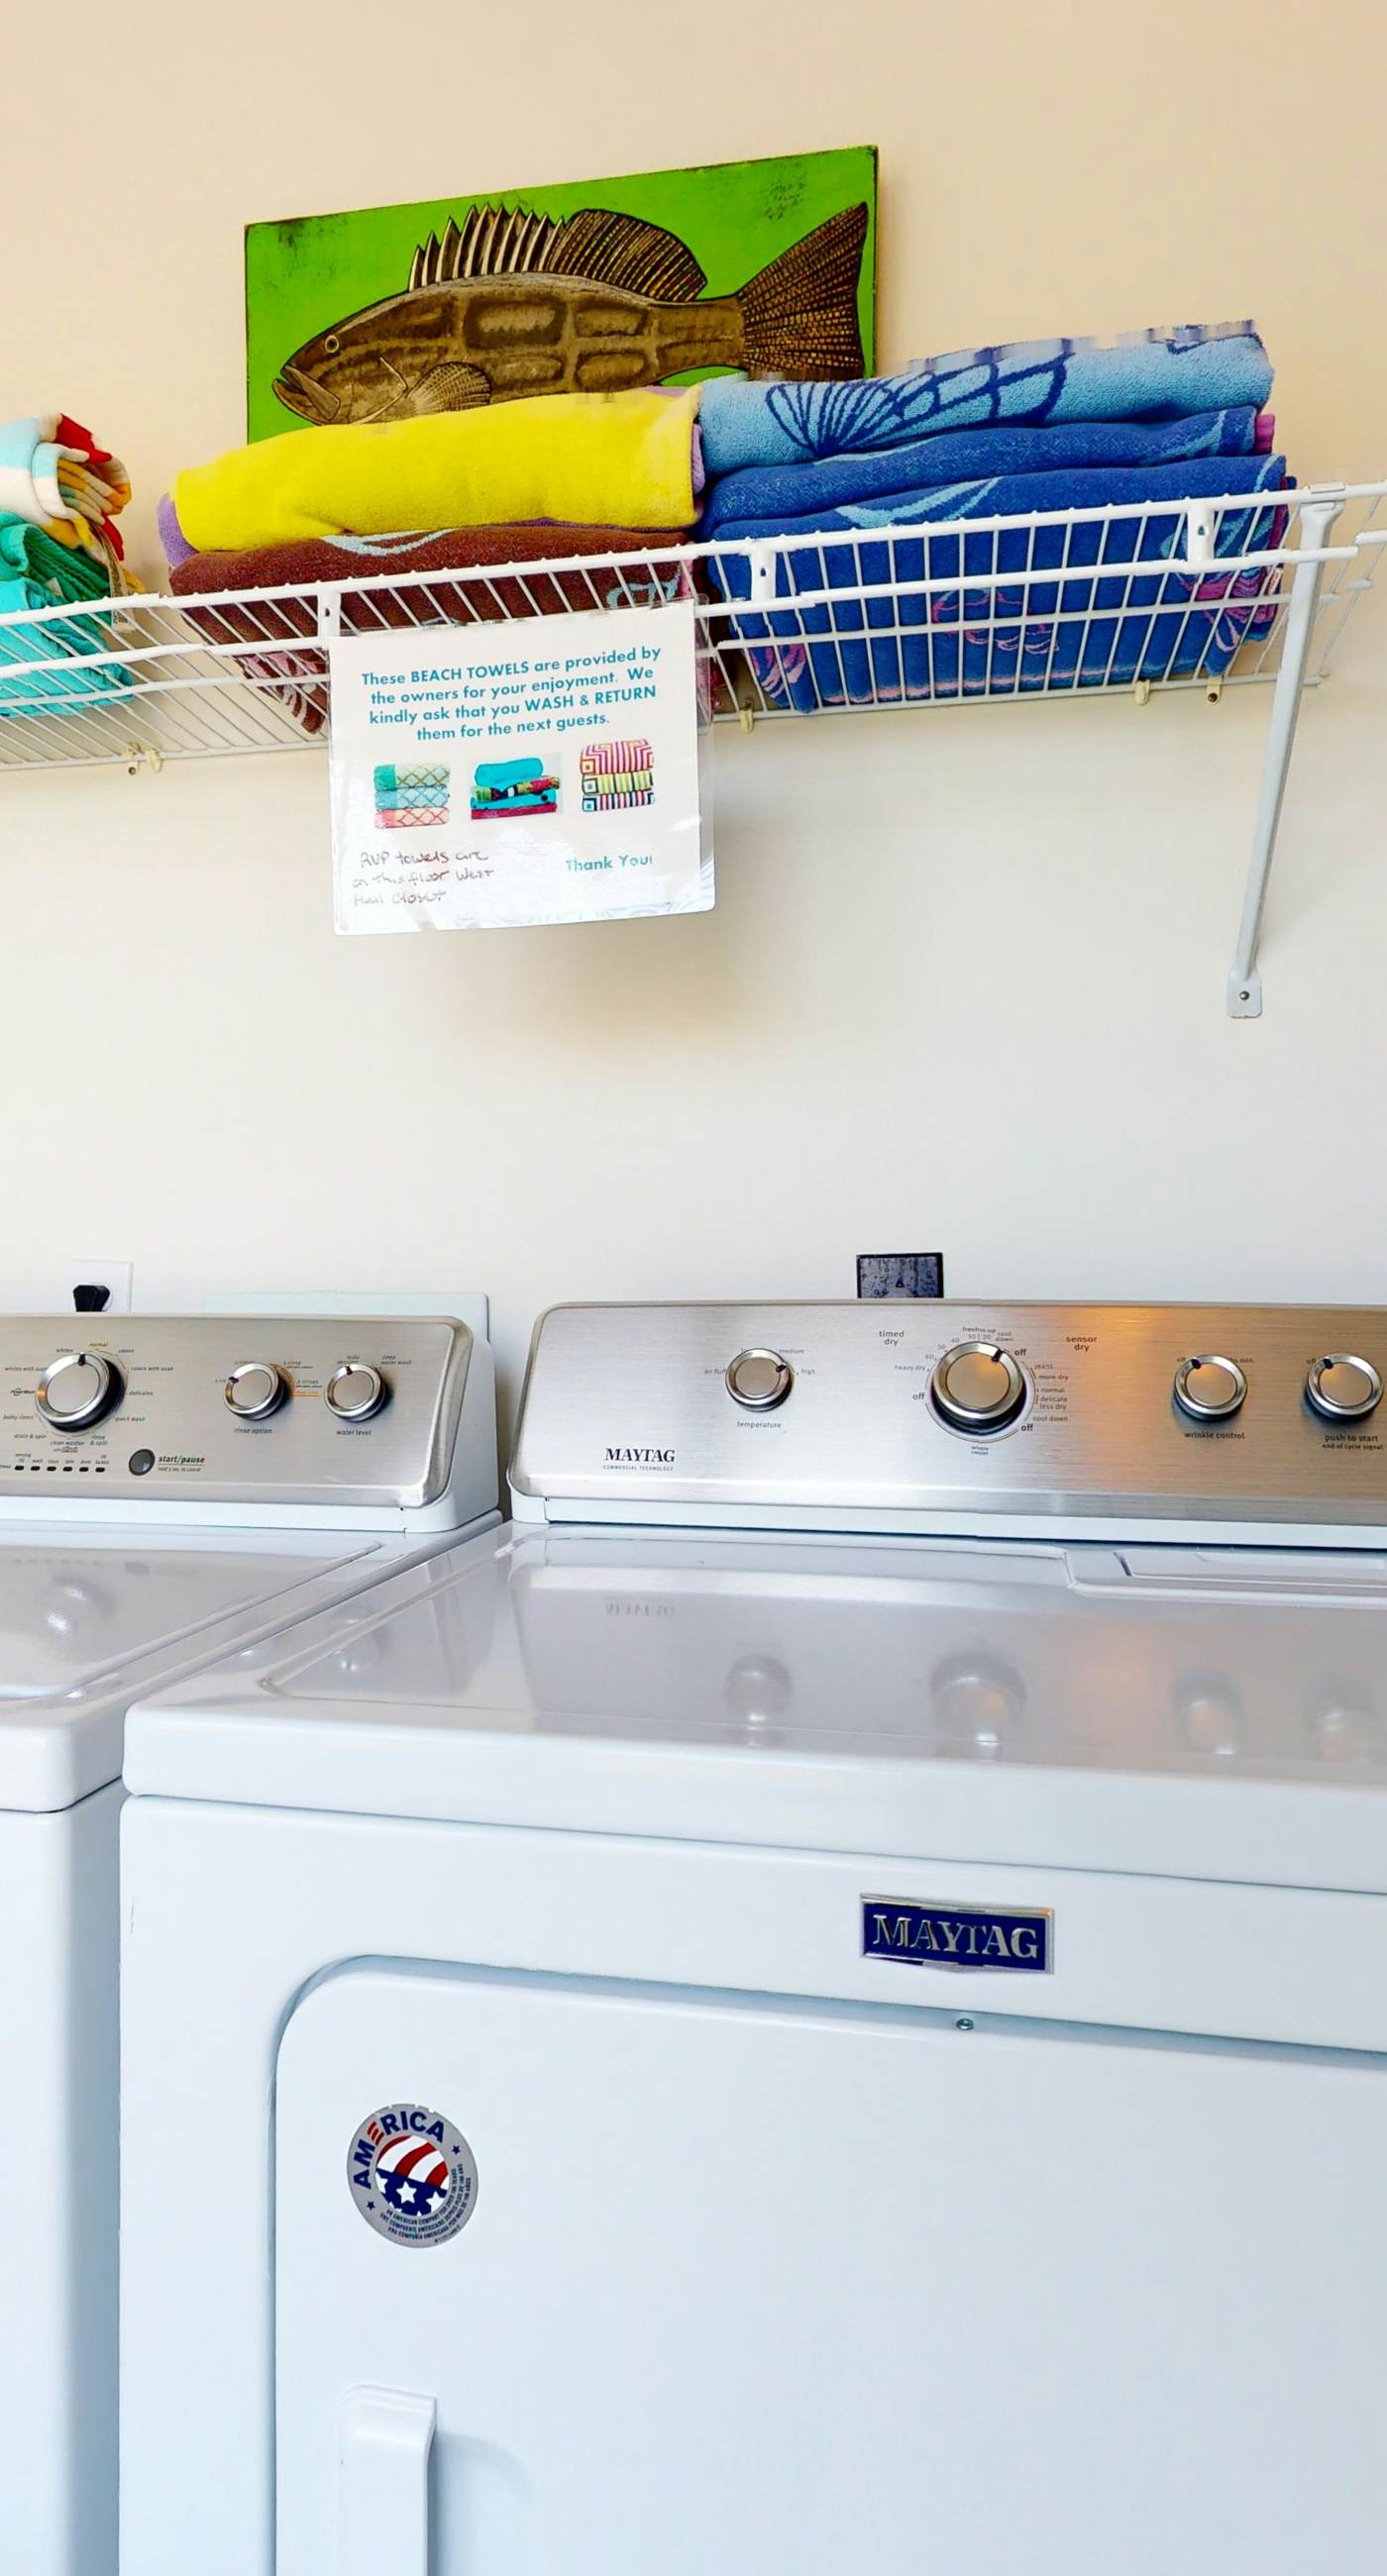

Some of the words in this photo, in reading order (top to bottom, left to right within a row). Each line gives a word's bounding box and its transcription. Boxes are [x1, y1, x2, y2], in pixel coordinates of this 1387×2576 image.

[362, 671, 405, 685] These
[411, 668, 462, 683] BEACH
[467, 661, 529, 679] TOWELS
[534, 661, 560, 672] are
[565, 647, 636, 672] provided
[641, 646, 662, 662] by
[371, 691, 395, 704] the
[400, 689, 459, 703] owners
[464, 684, 486, 698] for
[490, 683, 527, 699] your
[627, 667, 654, 680] We
[370, 709, 417, 725] kindly
[423, 707, 450, 720] ask
[455, 705, 485, 718] that
[490, 704, 520, 719] you
[525, 695, 574, 711] WASH
[580, 694, 589, 706] &
[594, 685, 656, 704] RETURN
[417, 727, 456, 740] them
[460, 724, 483, 737] for
[488, 723, 511, 736] the
[517, 718, 551, 733] next
[556, 714, 610, 731] guests.
[396, 851, 449, 865] towels
[565, 856, 612, 872] Thank
[884, 1338, 899, 1347] dry
[1074, 1343, 1090, 1352] dry
[736, 1420, 782, 1429] temperature
[159, 1455, 205, 1465] start/pause
[603, 1448, 676, 1463] MAYTAG
[872, 1913, 1038, 1959] MAYTAG
[353, 2111, 445, 2190] AMERICA
